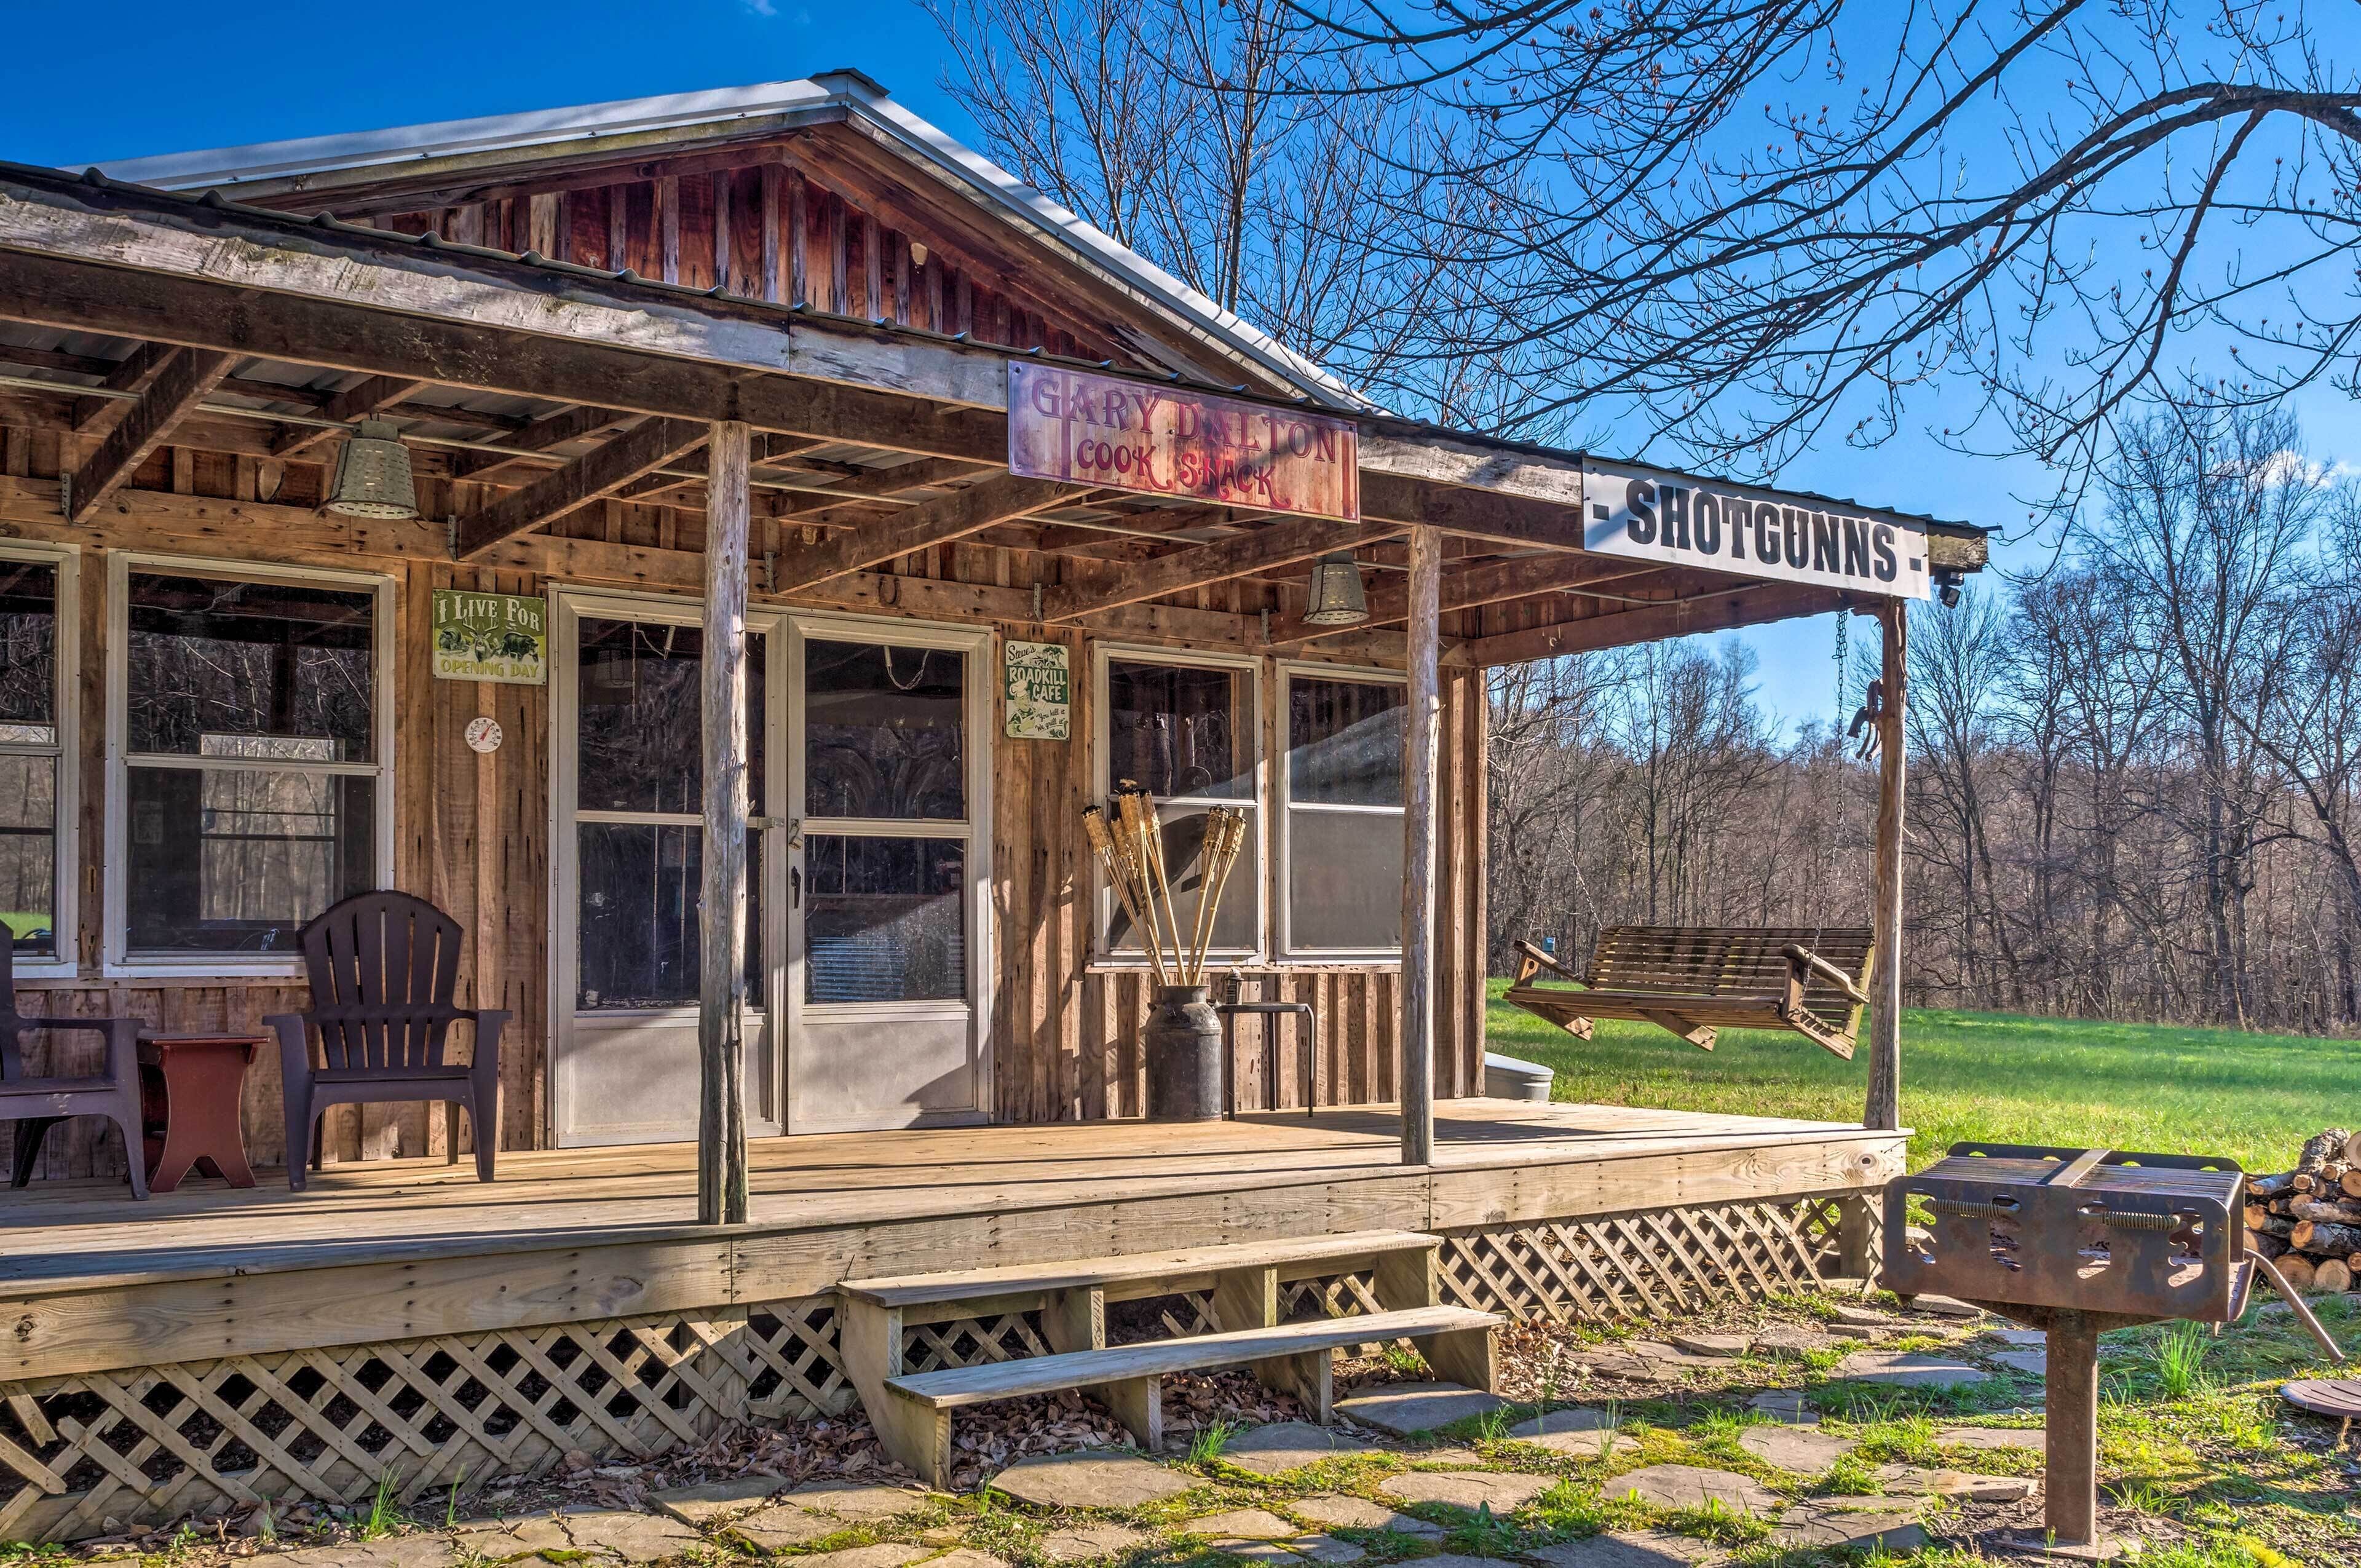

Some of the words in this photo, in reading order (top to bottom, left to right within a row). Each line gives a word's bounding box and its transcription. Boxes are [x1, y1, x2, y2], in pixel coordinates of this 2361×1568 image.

[1032, 377, 1165, 433] GARY
[1177, 402, 1338, 464] DALTON
[1077, 438, 1173, 491] COOK
[1179, 453, 1292, 509] SHACK
[1626, 479, 1897, 582] SHOTGUNNS
[438, 599, 448, 624] I
[454, 595, 498, 620] LIVE
[504, 598, 540, 632] FOR
[1008, 644, 1037, 661] Steve's
[440, 659, 504, 677] OPENING
[510, 663, 539, 678] DAY
[1009, 667, 1067, 686] ROADKILL
[1033, 684, 1062, 701] CAFE
